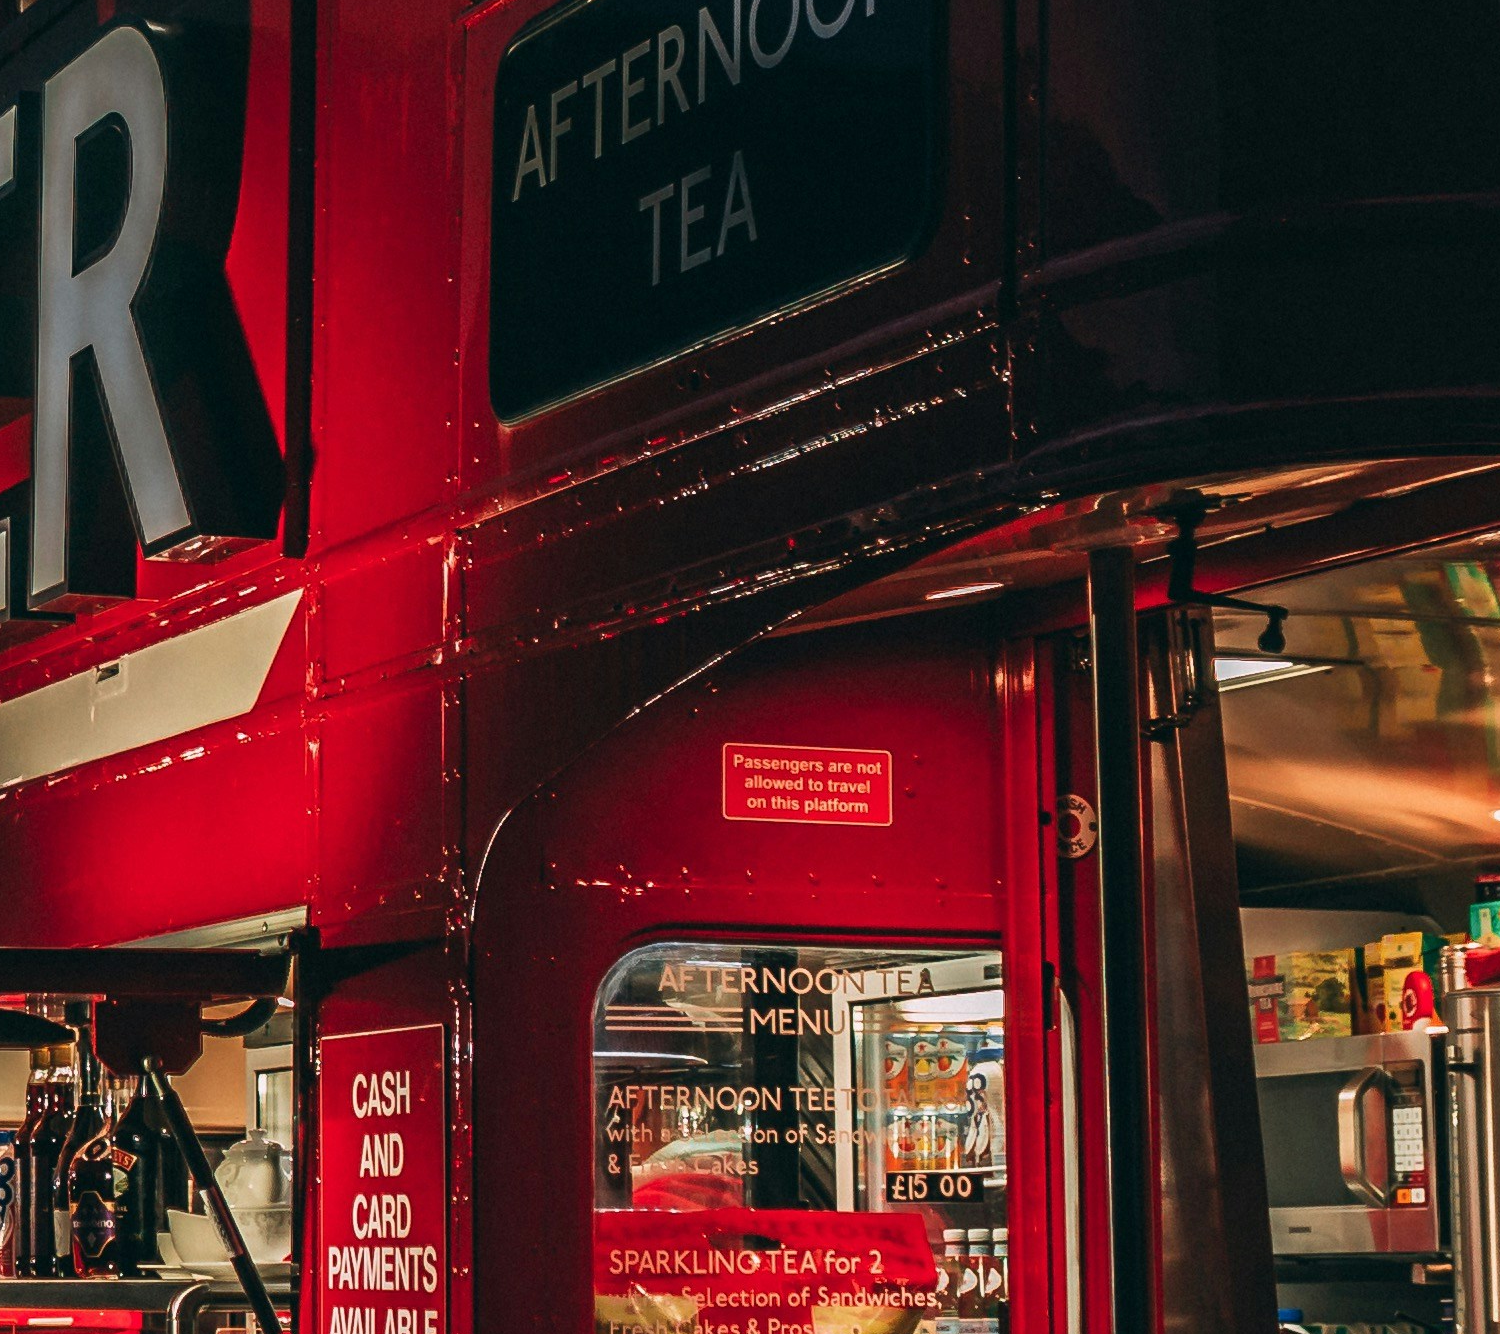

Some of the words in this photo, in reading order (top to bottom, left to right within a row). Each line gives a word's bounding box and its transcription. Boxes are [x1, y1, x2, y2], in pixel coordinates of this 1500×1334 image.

[638, 149, 758, 287] TEA
[733, 753, 824, 775] Passengers
[828, 761, 852, 774] are
[857, 760, 882, 775] not
[744, 774, 804, 791] allowed
[808, 777, 823, 791] to
[828, 778, 870, 794] travel
[747, 796, 767, 809] on
[771, 795, 800, 811] this
[804, 797, 869, 814] platform
[657, 966, 866, 995] AFTERNOON
[880, 968, 936, 995] TEA
[749, 1008, 846, 1036] MENU
[352, 1070, 411, 1119] CASH
[607, 1086, 782, 1112] AFTERNOON
[607, 1123, 653, 1143] with
[785, 1123, 808, 1144] of
[359, 1132, 404, 1178] AND
[608, 1153, 621, 1174] &
[694, 1157, 760, 1175] Cakes
[352, 1194, 412, 1240] CARD
[327, 1246, 438, 1293] PAYMENTS
[609, 1250, 760, 1275] SPARKLING
[768, 1250, 818, 1275] TEA
[824, 1252, 861, 1275] for
[869, 1250, 884, 1275] 2
[680, 1286, 781, 1308] Selection
[788, 1286, 810, 1308] of
[817, 1287, 943, 1310] Sandwiches,
